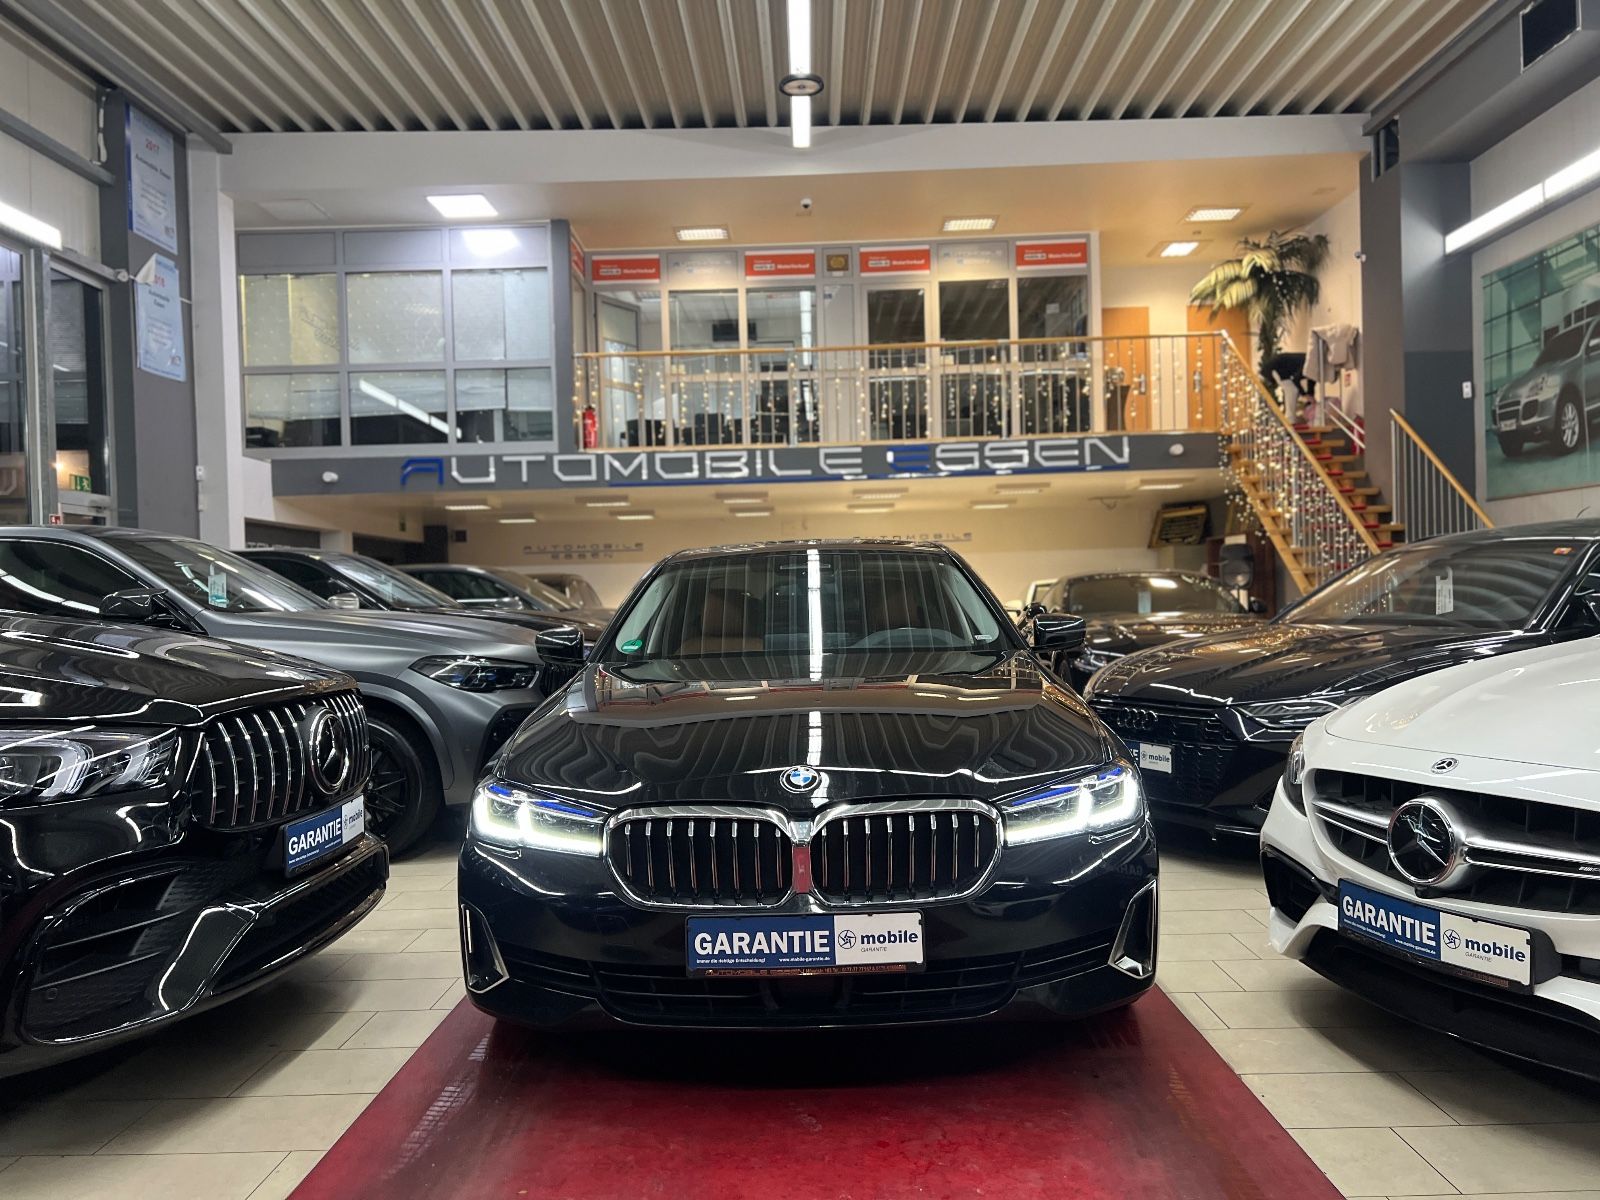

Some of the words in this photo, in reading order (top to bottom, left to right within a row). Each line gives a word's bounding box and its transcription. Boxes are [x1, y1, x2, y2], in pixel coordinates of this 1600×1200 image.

[401, 448, 862, 485] AUTOMOBILE
[886, 436, 1130, 473] ESSEN
[523, 542, 644, 551] AUTOMOBILE
[1148, 754, 1170, 763] mobile
[288, 818, 342, 855] GARANTIE
[694, 930, 830, 955] GARANTIE
[860, 930, 918, 945] mobile
[1342, 895, 1437, 947] GARANTIE
[1465, 938, 1526, 962] mobile
